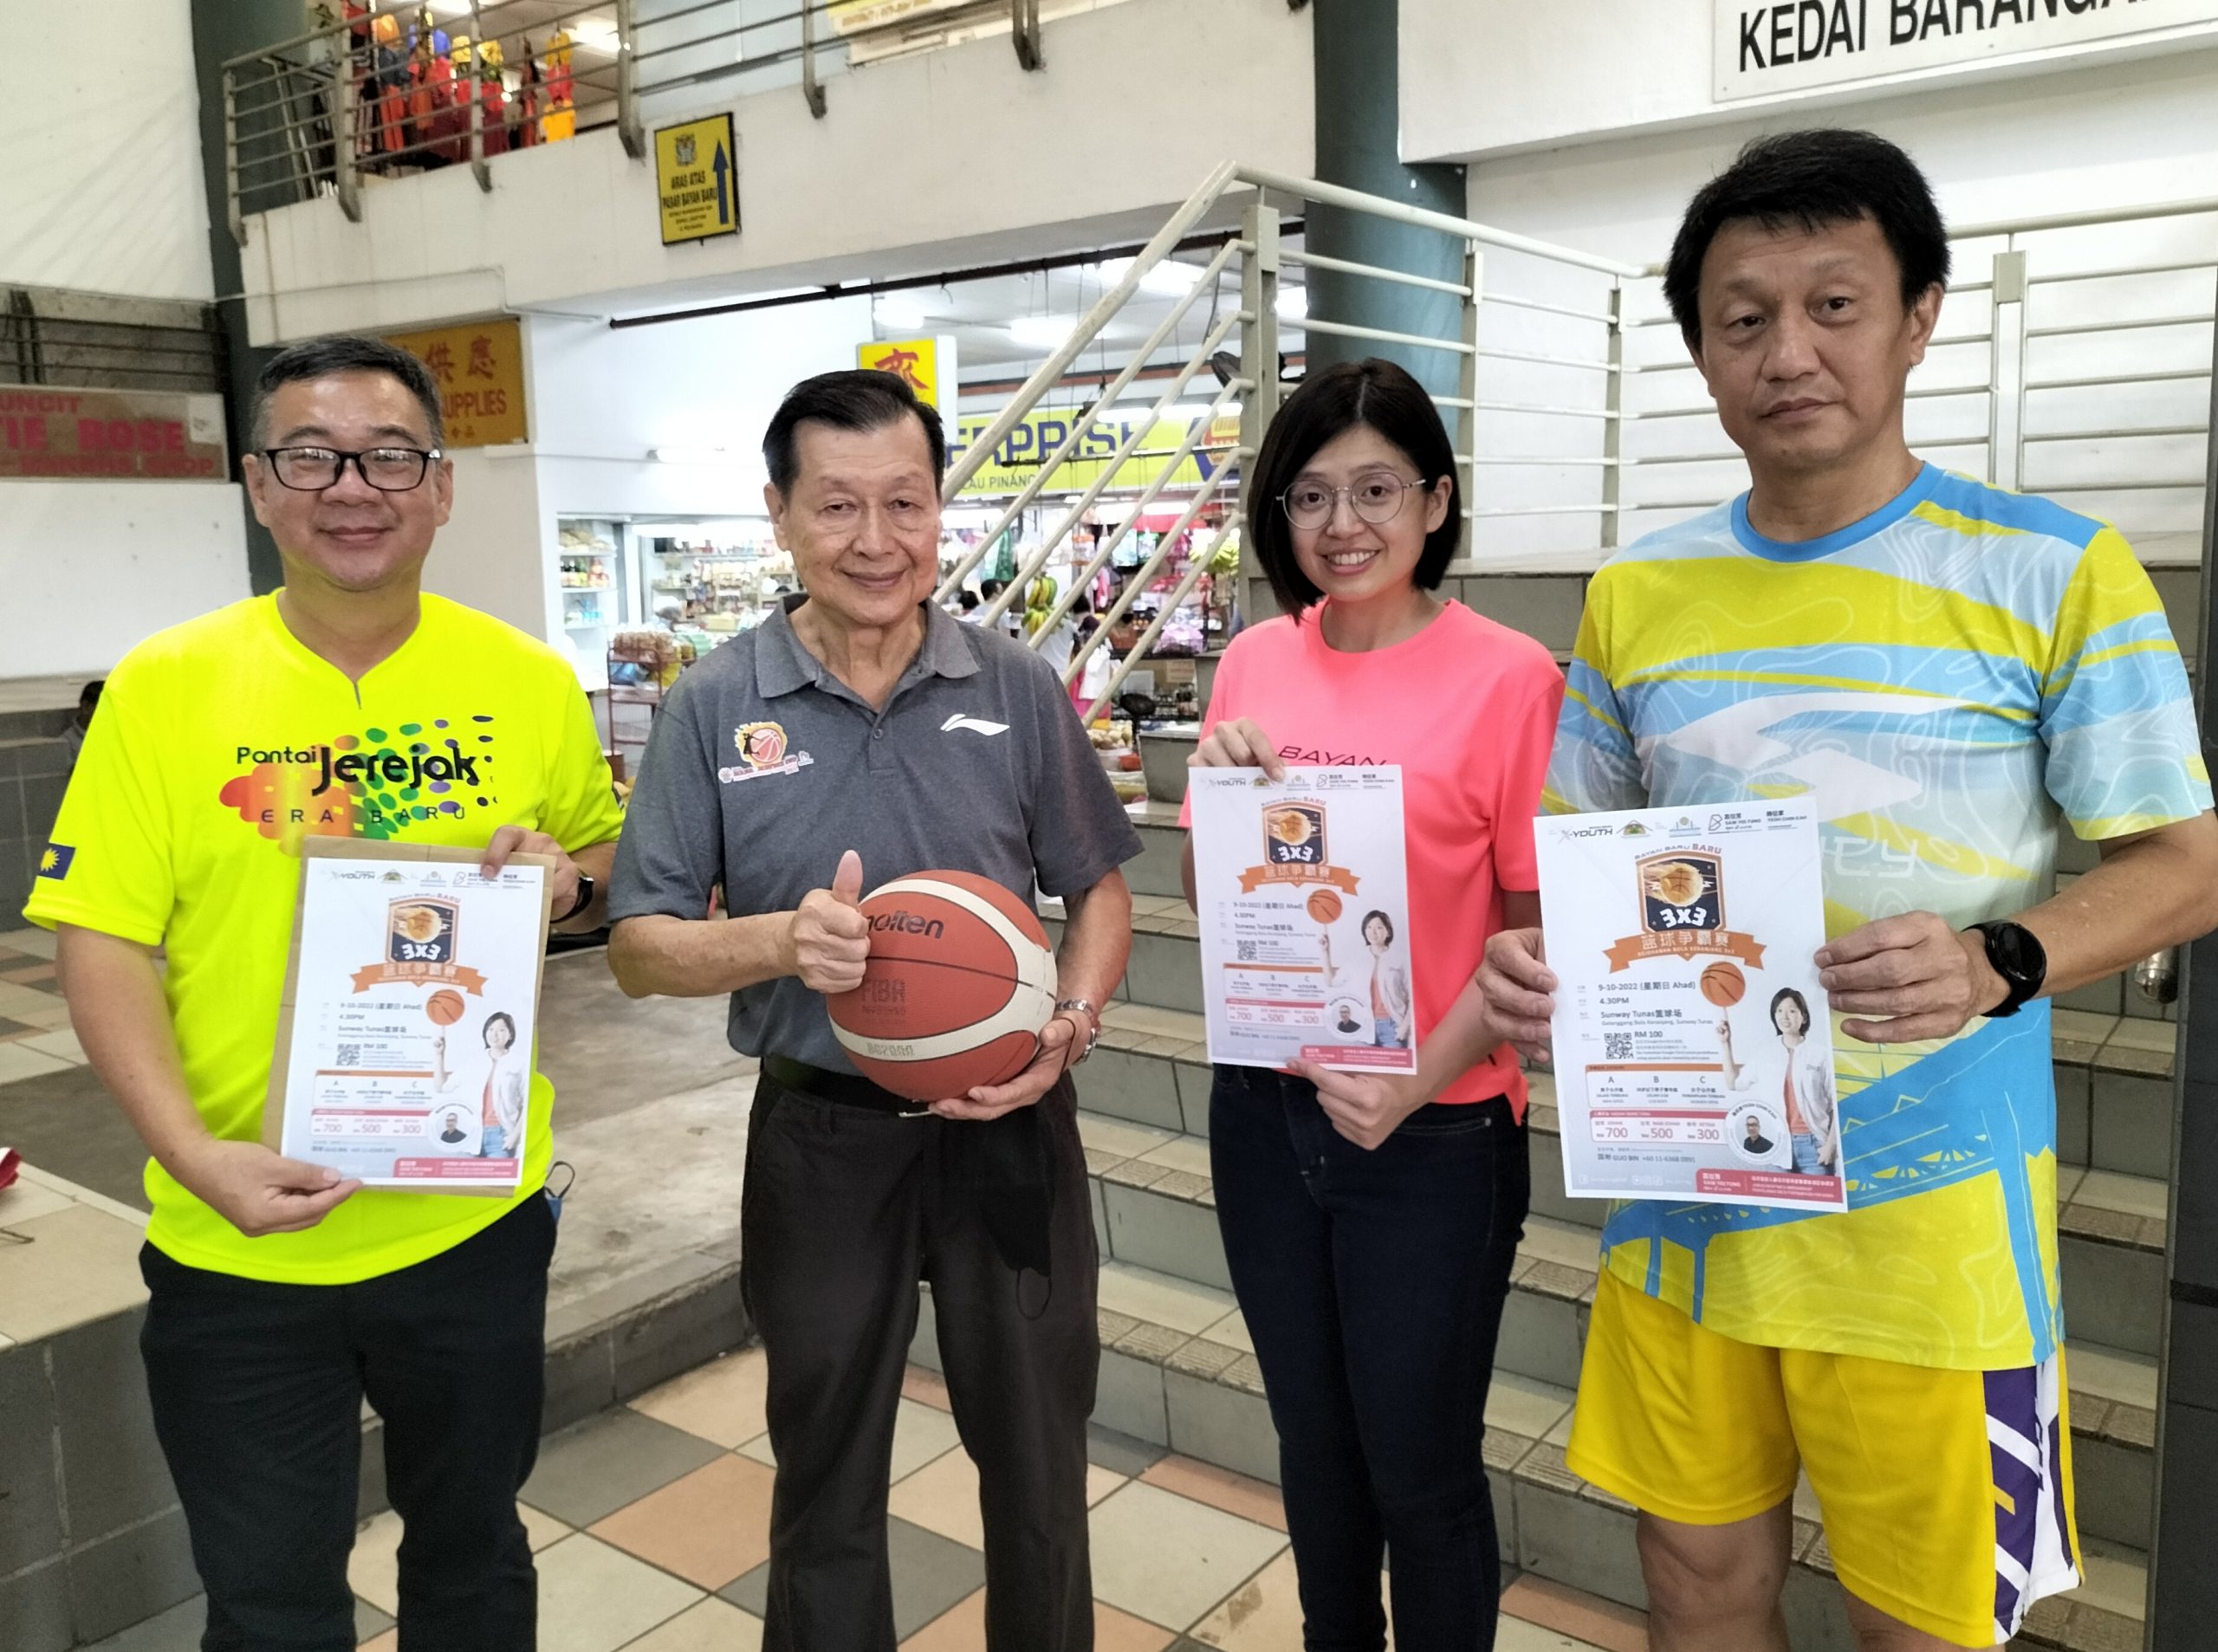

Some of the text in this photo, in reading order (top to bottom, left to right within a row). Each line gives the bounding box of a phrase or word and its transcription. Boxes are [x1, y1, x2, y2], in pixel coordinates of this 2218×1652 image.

[1740, 0, 1865, 72] KEDAI
[442, 389, 508, 418] UPPLIES
[0, 416, 47, 450] IE
[237, 743, 478, 796] Pantai Jerejak
[261, 806, 466, 824] ERA BARU
[1599, 982, 1638, 991] 9-10-2022
[1605, 1127, 1628, 1138] 700
[1651, 1128, 1673, 1138] 500
[1697, 1129, 1720, 1140] 300
